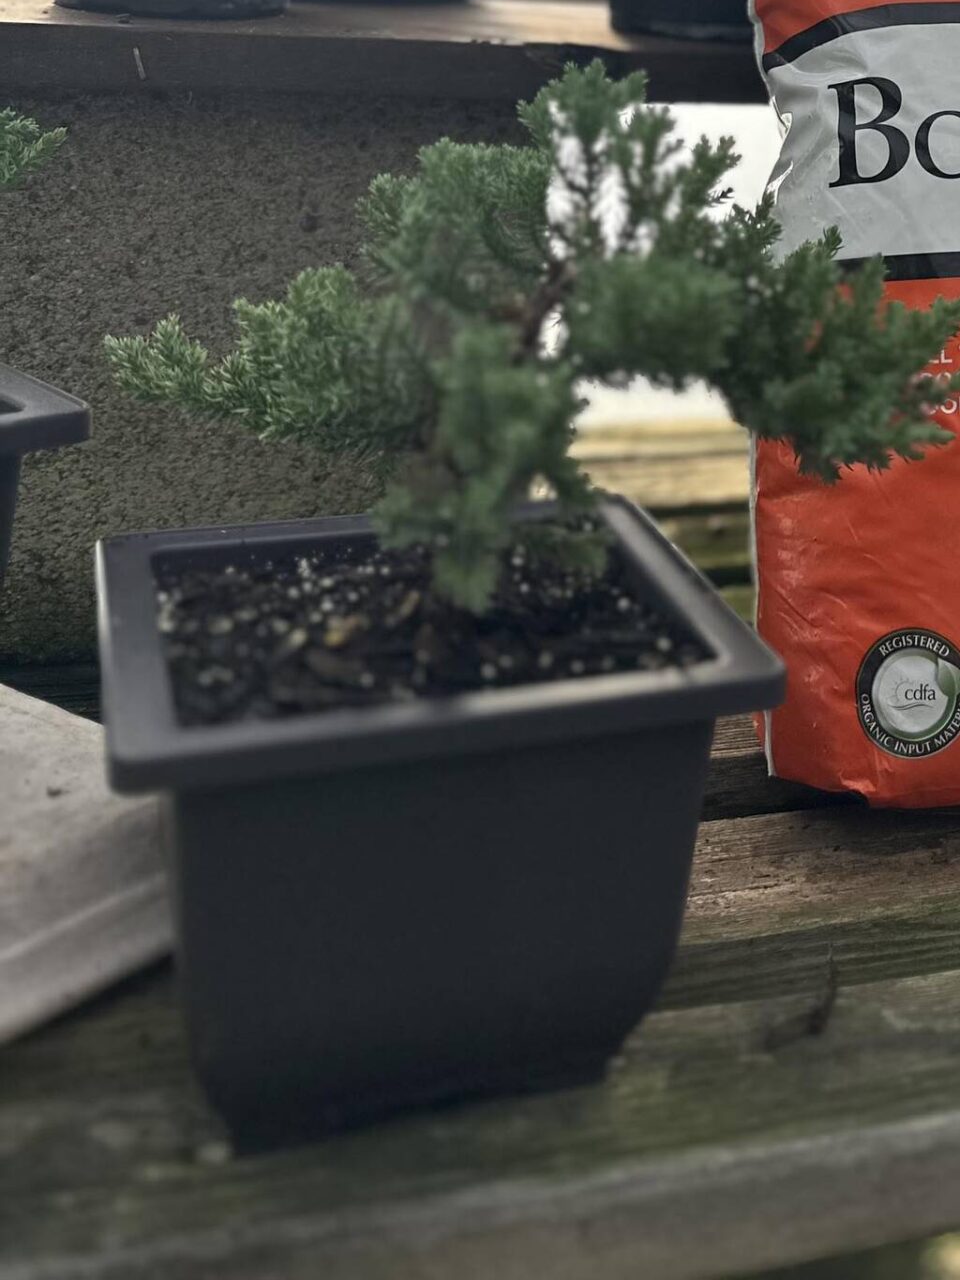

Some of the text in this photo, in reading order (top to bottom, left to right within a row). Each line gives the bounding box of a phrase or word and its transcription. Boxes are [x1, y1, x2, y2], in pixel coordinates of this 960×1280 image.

[879, 634, 950, 657] REGISTERED
[904, 683, 936, 701] cdfa
[861, 693, 894, 747] ORGANIC
[894, 740, 932, 754] INPUT
